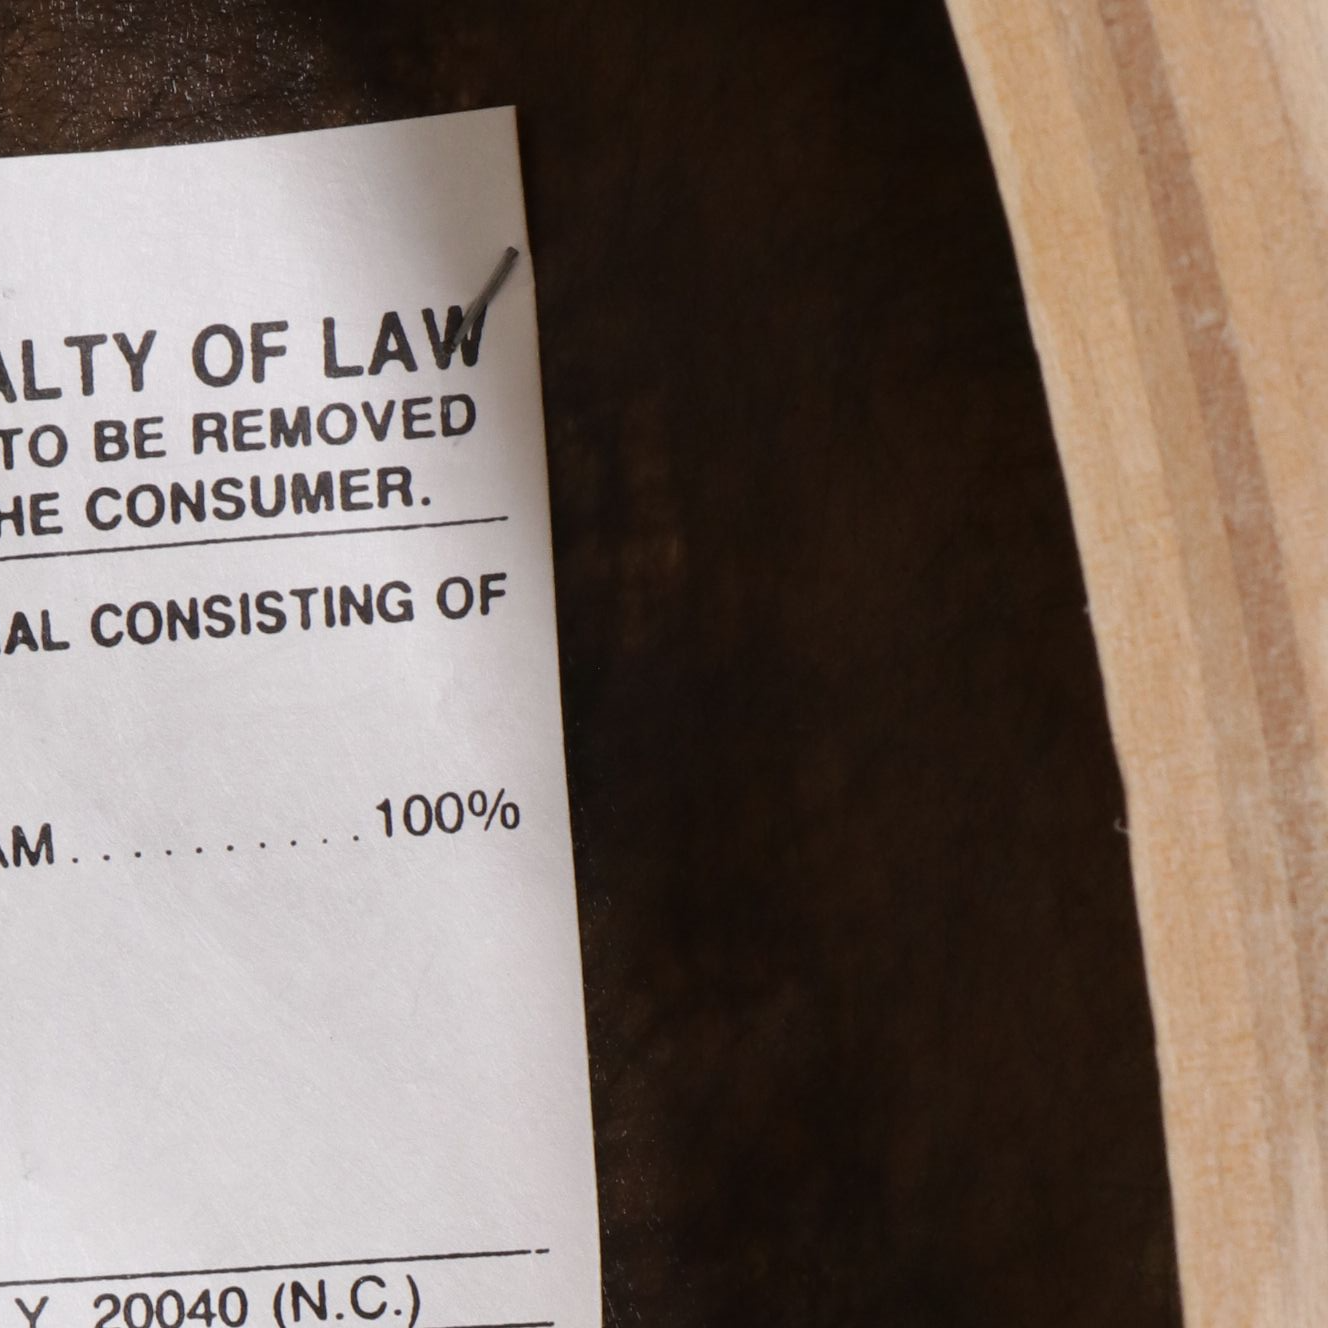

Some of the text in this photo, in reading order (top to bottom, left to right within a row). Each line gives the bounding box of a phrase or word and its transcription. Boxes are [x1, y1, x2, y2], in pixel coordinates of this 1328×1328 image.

[192, 320, 288, 388] OF
[323, 304, 489, 378] LAW
[94, 416, 166, 463] BE
[192, 394, 476, 455] REMOVED
[85, 466, 430, 531] CONSUMER.
[91, 581, 414, 648] CONSISTING
[437, 572, 507, 620] OF
[376, 788, 520, 838] 100%
